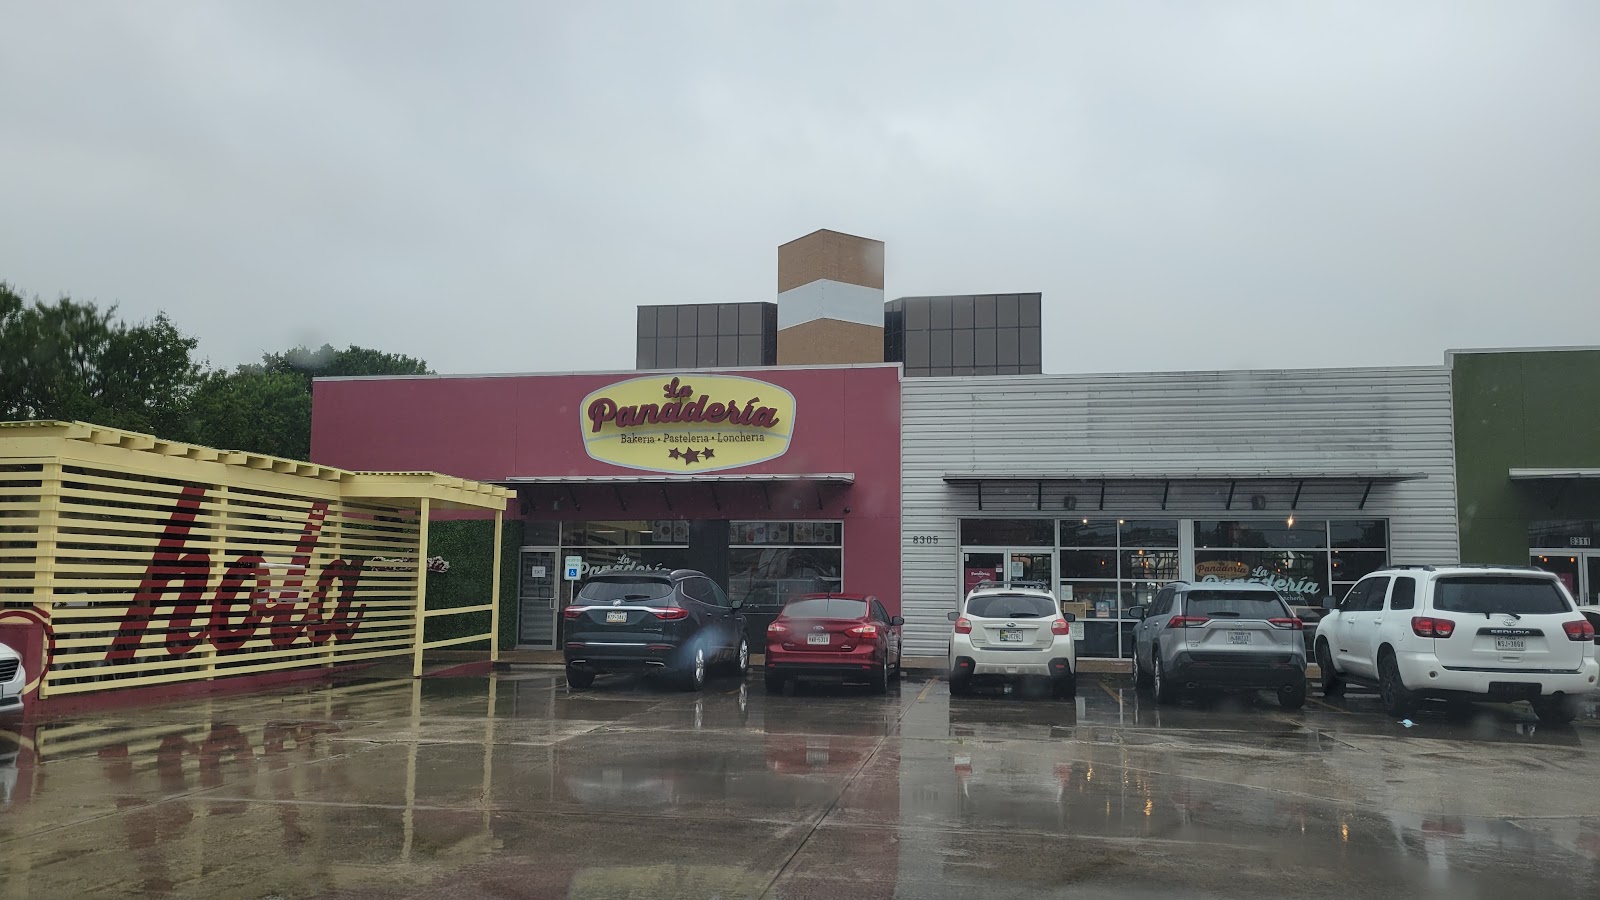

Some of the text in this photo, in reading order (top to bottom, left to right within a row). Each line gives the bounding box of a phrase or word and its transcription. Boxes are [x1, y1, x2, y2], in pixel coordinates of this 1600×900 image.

[663, 377, 693, 398] La
[588, 395, 780, 433] Panadería
[913, 535, 939, 545] 8305
[617, 554, 631, 564] La
[104, 487, 367, 660] hola
[1252, 565, 1269, 578] La
[1202, 574, 1320, 595] dería
